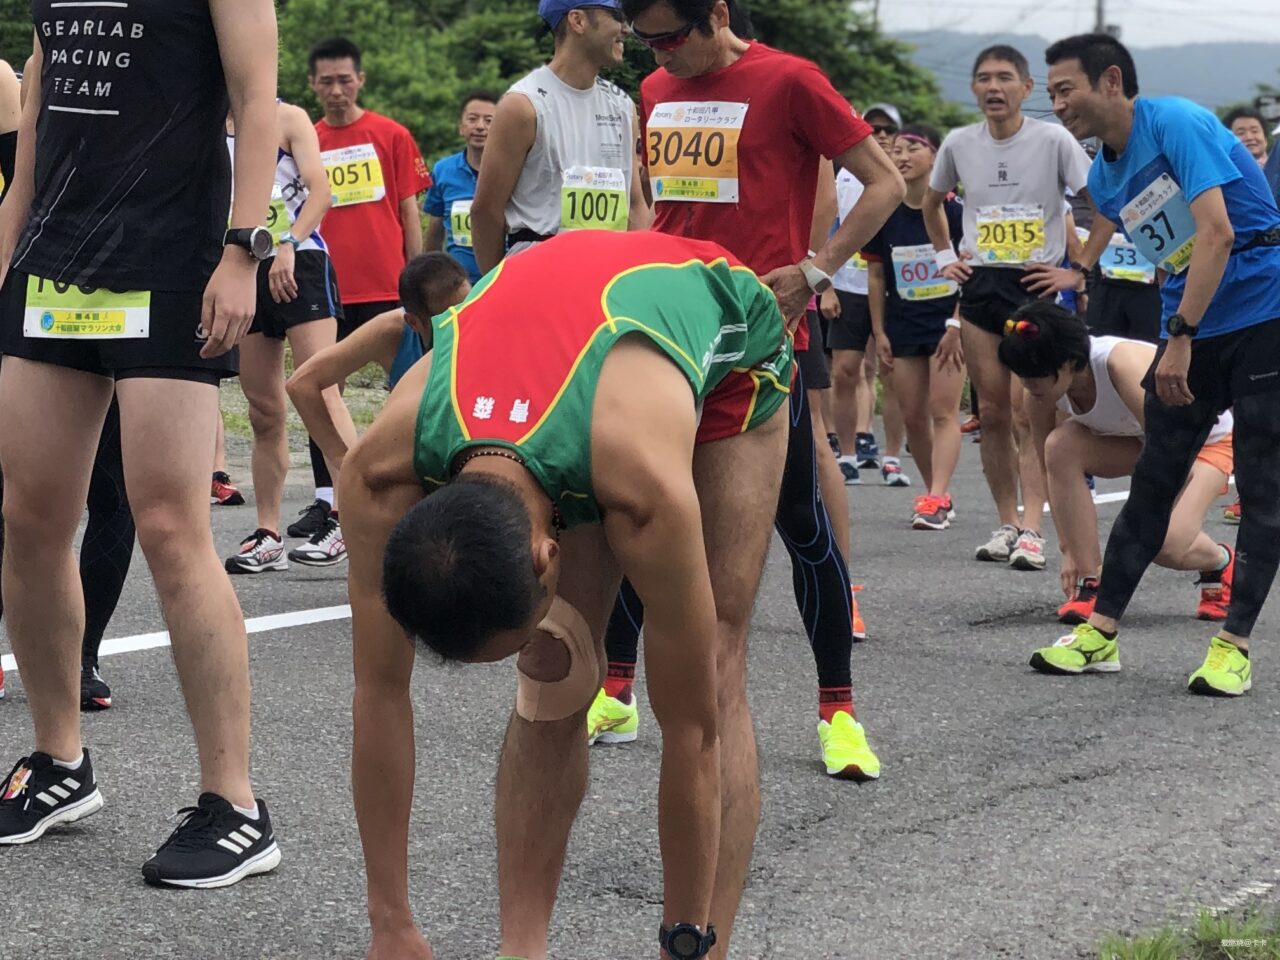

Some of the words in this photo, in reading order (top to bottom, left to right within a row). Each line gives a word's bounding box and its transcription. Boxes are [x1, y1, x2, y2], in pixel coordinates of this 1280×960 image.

[42, 19, 145, 39] GEARLAB
[54, 77, 112, 98] TEAM
[649, 130, 725, 167] 3040
[326, 161, 372, 188] 051
[567, 191, 620, 222] 1007
[980, 222, 1036, 244] 2015
[1140, 210, 1176, 252] 37
[1113, 247, 1137, 266] 53
